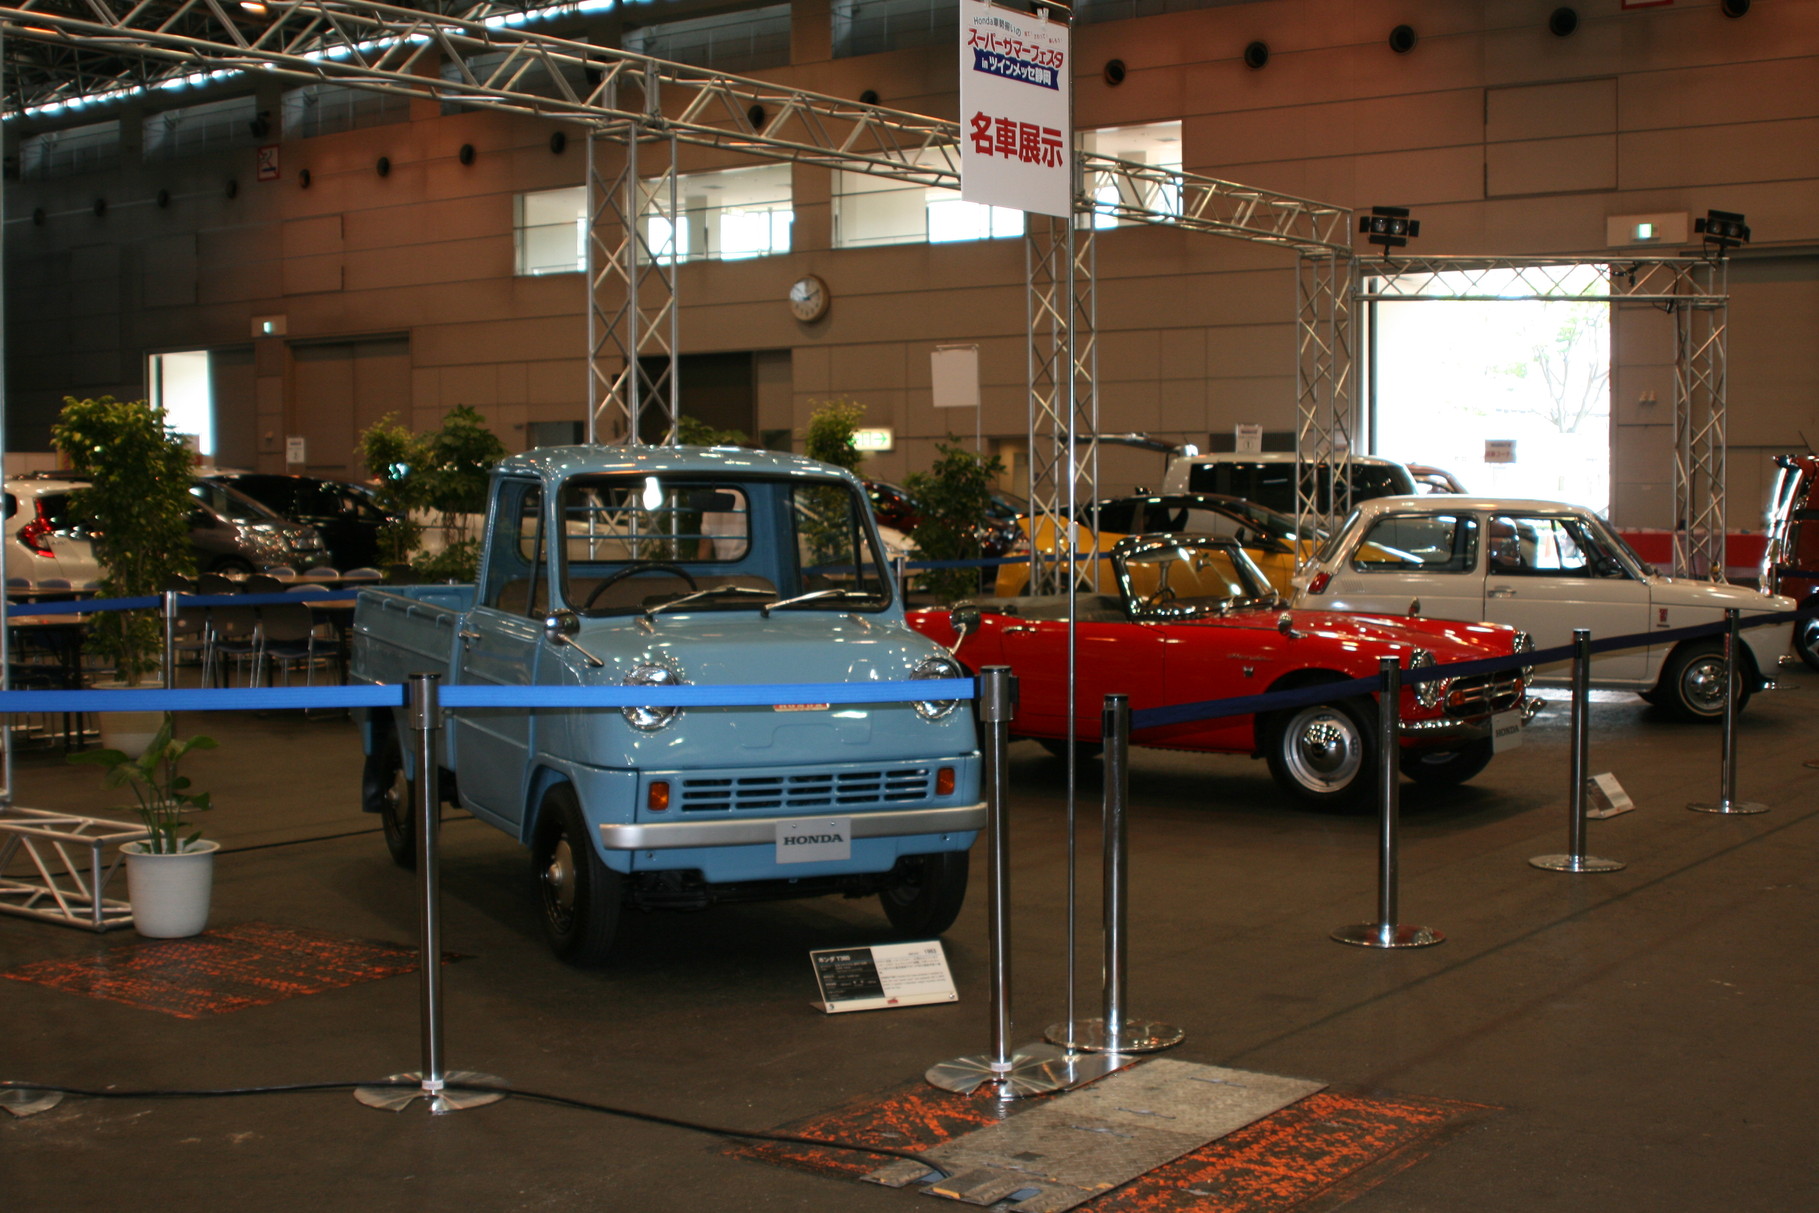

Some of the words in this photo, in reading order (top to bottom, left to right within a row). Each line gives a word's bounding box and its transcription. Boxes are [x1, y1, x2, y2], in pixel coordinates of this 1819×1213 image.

[967, 28, 1064, 69] スーパーサマーフェスタ
[981, 57, 989, 69] in
[969, 111, 1064, 169] 名車展示
[783, 833, 844, 846] HONDA
